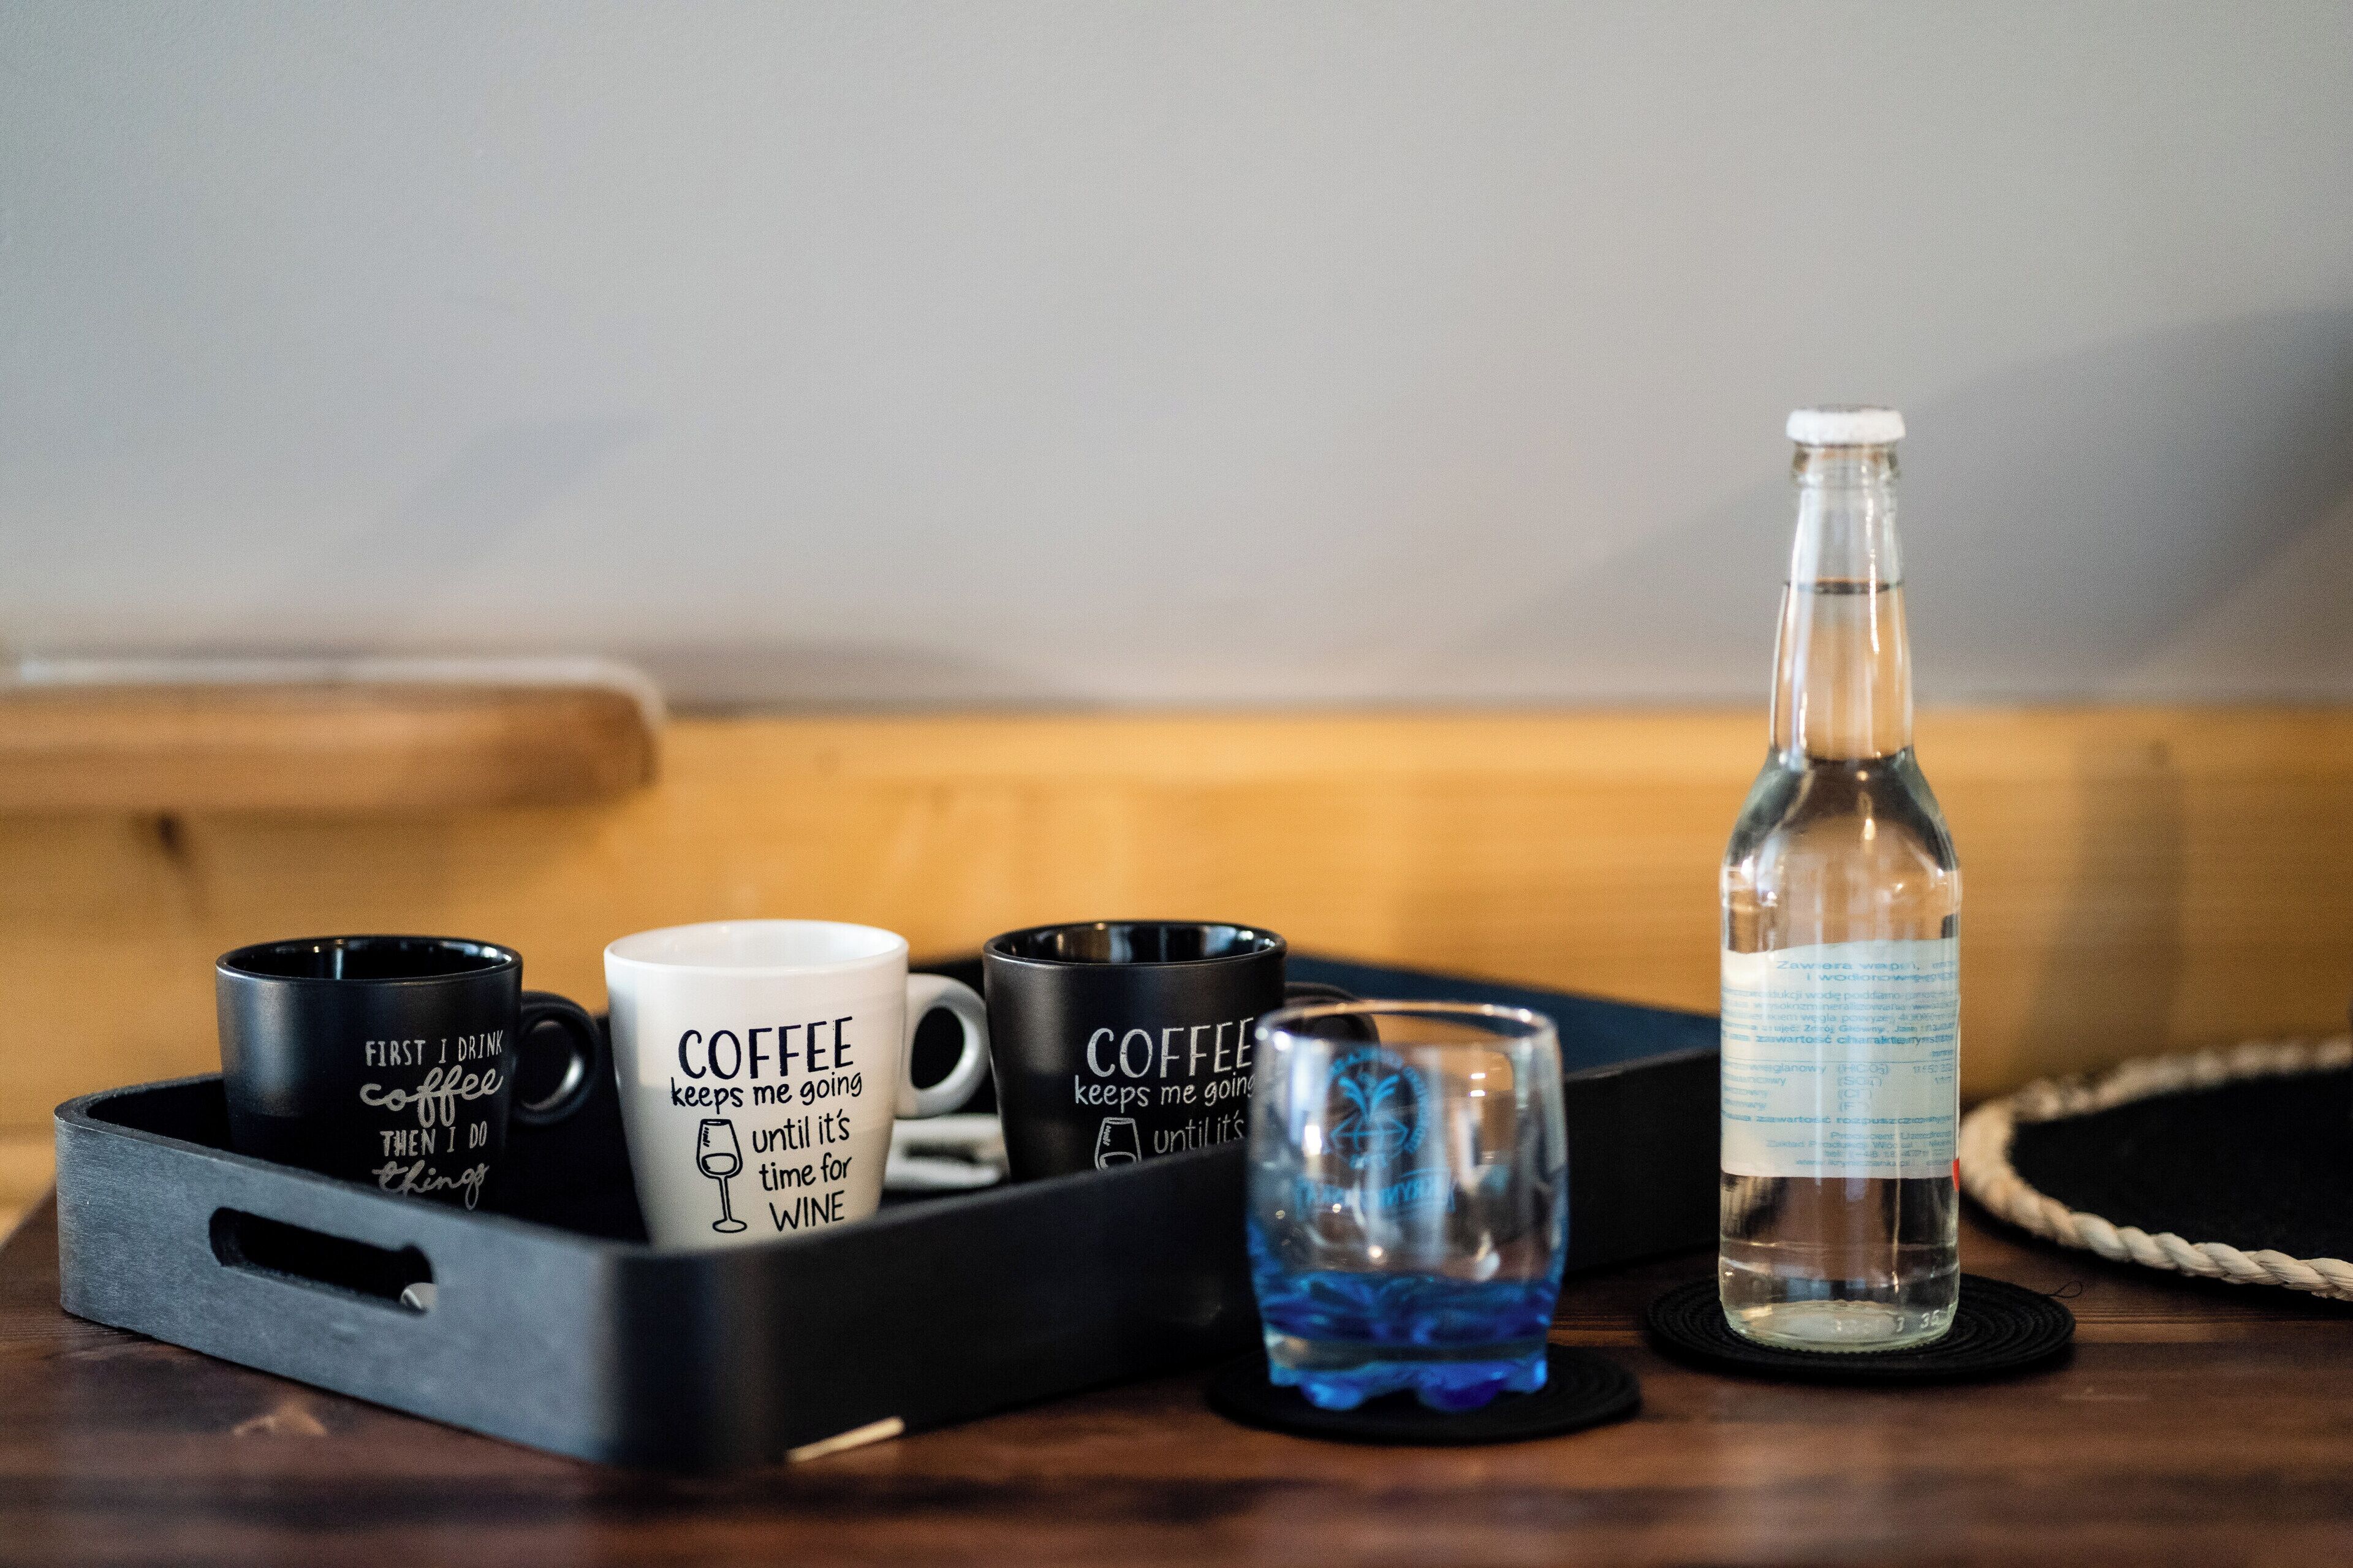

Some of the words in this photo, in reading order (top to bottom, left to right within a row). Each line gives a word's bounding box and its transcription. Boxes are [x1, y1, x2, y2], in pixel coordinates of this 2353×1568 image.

[365, 1040, 426, 1067] FIRST
[439, 1038, 447, 1064] I
[458, 1029, 503, 1062] DRINK
[678, 1016, 854, 1080] COFFEE
[1086, 1017, 1254, 1078] COFFEE
[360, 1065, 504, 1128] coffee
[670, 1077, 744, 1115] keeps
[753, 1083, 792, 1105] me
[800, 1072, 862, 1105] going
[1075, 1075, 1151, 1114] keeps
[1161, 1084, 1197, 1105] me
[379, 1129, 436, 1157] THEN
[447, 1126, 456, 1153] I
[469, 1121, 487, 1149] DO
[752, 1115, 810, 1153] until
[819, 1108, 851, 1145] it's
[1154, 1116, 1209, 1154] until
[759, 1162, 816, 1191] time
[820, 1152, 852, 1183] for
[769, 1190, 845, 1232] WINE
